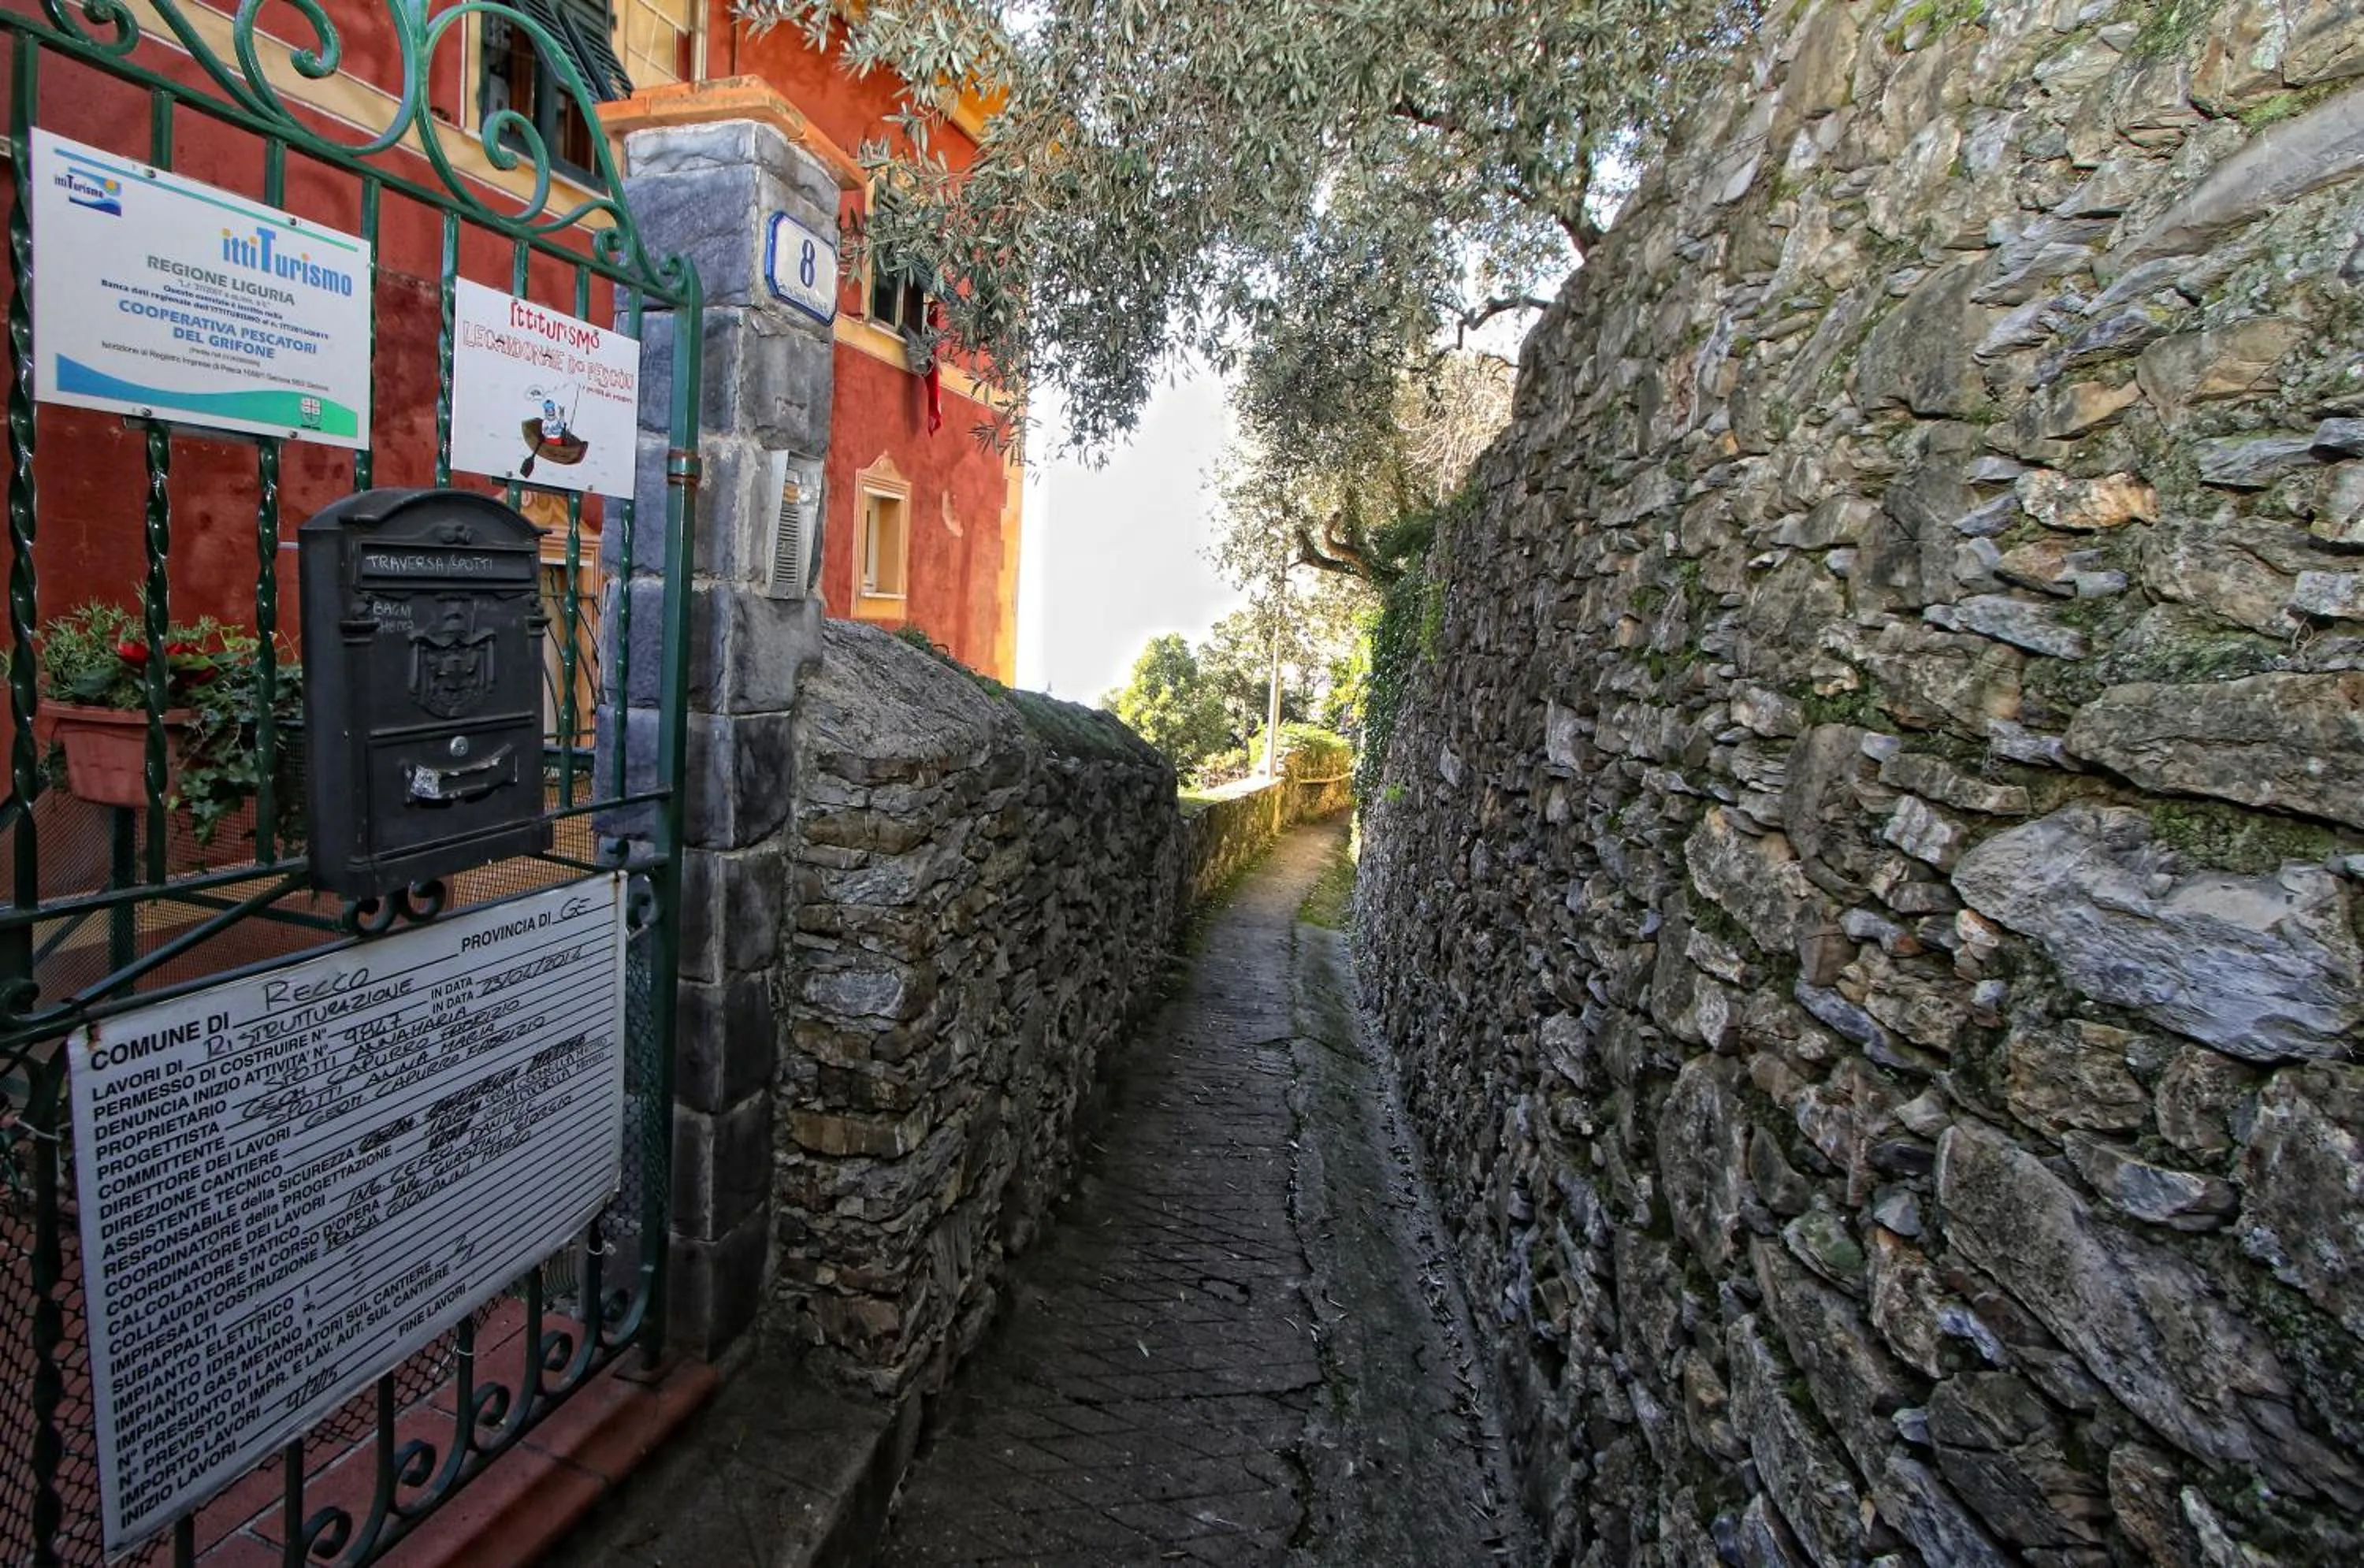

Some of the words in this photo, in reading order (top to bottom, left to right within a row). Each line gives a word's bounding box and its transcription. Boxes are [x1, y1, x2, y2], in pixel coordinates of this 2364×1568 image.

[147, 255, 228, 288] REGIONE
[232, 279, 296, 306] LIGURIA
[800, 239, 816, 288] 8
[119, 299, 236, 336] COOPERATIVA
[240, 328, 318, 354] PESCATORI
[173, 327, 203, 344] DEL
[209, 335, 275, 359] GRIFONE
[461, 915, 534, 953] PROVINCIA
[538, 911, 550, 927] DI
[560, 892, 591, 920] GE
[430, 986, 441, 999] IN
[445, 975, 472, 994] DATA
[433, 1000, 443, 1014] IN
[446, 989, 473, 1009] DATA
[89, 1019, 200, 1073] COMUNE
[206, 1010, 229, 1034] DI
[91, 1065, 160, 1103] LAVORI
[165, 1058, 182, 1076] DI
[93, 1073, 194, 1123] PERMESSO
[199, 1065, 216, 1083] DI
[221, 1033, 307, 1076] COSTRUIRE
[95, 1094, 188, 1143] DENUNCIA
[192, 1074, 240, 1105] INIZIO
[96, 1098, 226, 1162] PROPRIETARIO
[96, 1118, 219, 1182] PROGETTISTA
[97, 1135, 225, 1202] COMMITTENTE
[99, 1162, 203, 1221] DIRETTORE
[206, 1150, 232, 1173] DEI
[235, 1124, 290, 1161] LAVORI
[100, 1184, 196, 1241] DIREZIONE
[200, 1147, 278, 1195] CANTIERE
[100, 1195, 211, 1261] ASSISTENTE
[214, 1162, 282, 1206] TECNICO
[103, 1202, 236, 1280] RESPONSABILE
[240, 1184, 274, 1212] della
[277, 1146, 354, 1194] SICUREZZA
[103, 1218, 241, 1299] COORDINATORE
[245, 1199, 279, 1228] della
[282, 1143, 392, 1209] PROGETTAZIONE
[105, 1235, 243, 1319] COORDINATORE
[246, 1221, 269, 1245] DEI
[274, 1193, 325, 1230] LAVORI
[106, 1258, 234, 1338] CALCOLATORE
[239, 1223, 299, 1265] STATICO
[108, 1269, 247, 1358] COLLAUDATORE
[251, 1258, 266, 1279] IN
[269, 1229, 319, 1268] CORSO
[323, 1196, 379, 1238] D'OPERA
[110, 1319, 188, 1377] IMPRESA
[192, 1307, 209, 1328] DI
[213, 1247, 318, 1317] COSTRUZIONE
[398, 1309, 424, 1338] FINE
[426, 1281, 466, 1319] LAVORI
[110, 1322, 217, 1396] SUBAPPALTI
[112, 1351, 200, 1415] IMPIANTO
[206, 1295, 293, 1358] ELETTRICO
[113, 1368, 203, 1435] IMPIANTO
[206, 1312, 293, 1377] IDRAULICO
[115, 1388, 199, 1453] IMPIANTO
[203, 1365, 236, 1397] GAS
[240, 1324, 302, 1373] METANO
[142, 1385, 232, 1455] PRESUNTO
[236, 1373, 251, 1395] DI
[255, 1315, 342, 1383] LAVORATORI
[346, 1298, 370, 1325] SUL
[373, 1258, 432, 1307] CANTIERE
[143, 1408, 226, 1474] PREVISTO
[230, 1395, 246, 1417] DI
[249, 1367, 289, 1405] IMPR.
[292, 1358, 303, 1376] E
[305, 1339, 333, 1368] LAV.
[336, 1319, 363, 1347] AUT.
[366, 1300, 391, 1328] SUL
[393, 1262, 450, 1310] CANTIERE
[119, 1444, 199, 1511] IMPORTO
[203, 1404, 259, 1453] LAVORI
[120, 1478, 177, 1530] INIZIO
[177, 1436, 237, 1490] LAVORI
